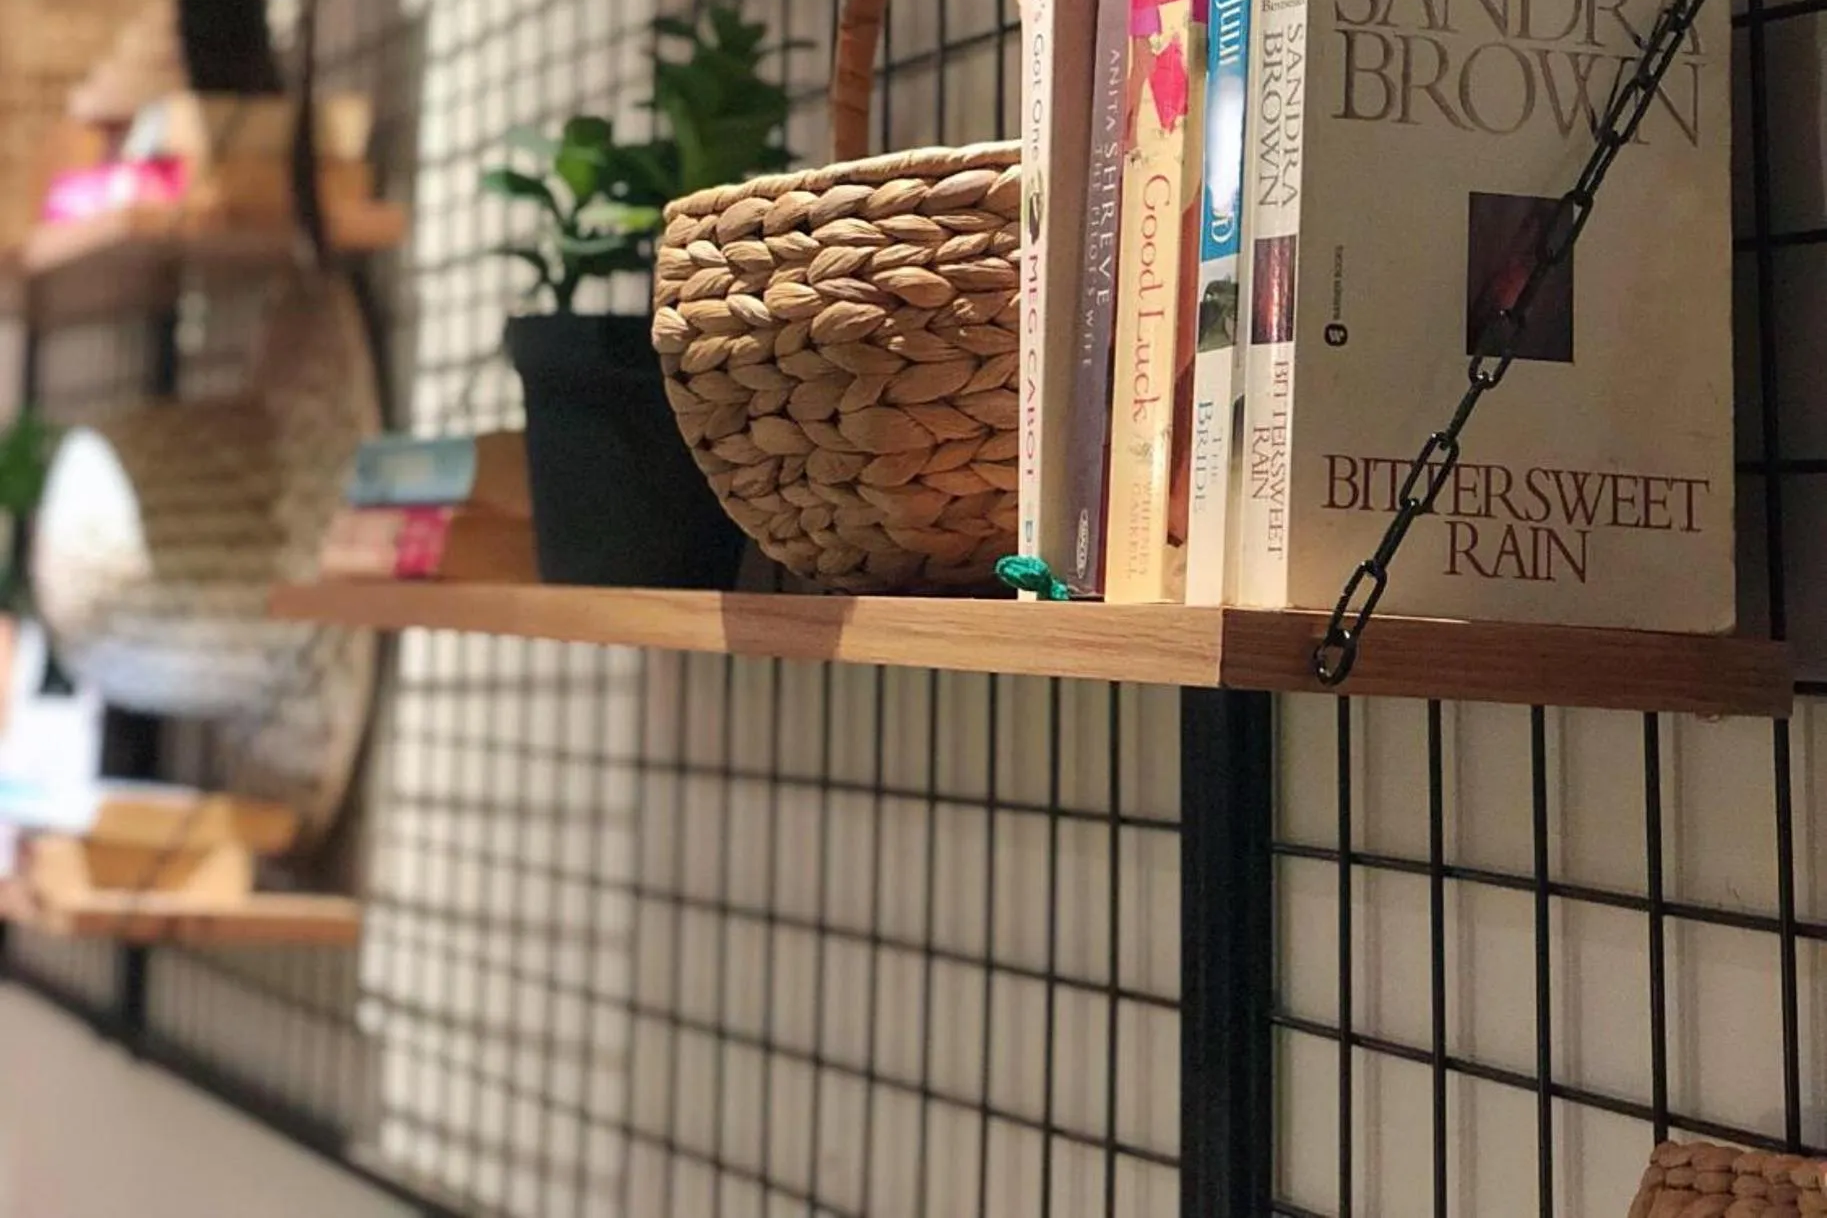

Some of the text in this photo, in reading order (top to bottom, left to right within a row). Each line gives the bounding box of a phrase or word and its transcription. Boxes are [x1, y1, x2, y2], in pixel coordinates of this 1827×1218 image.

[1031, 32, 1046, 90] Got
[1257, 30, 1285, 209] BROWN
[1280, 23, 1304, 208] SANDRA
[1332, 28, 1707, 149] BROWN
[1030, 98, 1045, 162] One
[1096, 48, 1121, 305] ANITA SHREVE
[1082, 309, 1095, 367] WIFE
[1133, 174, 1171, 422] Good Luck
[1024, 253, 1040, 479] MEG CABOT
[1252, 427, 1272, 501] RAIN
[1267, 359, 1291, 560] BITTERSWEET
[1321, 454, 1710, 533] BITTERSWEET
[1443, 520, 1592, 584] RAIN
